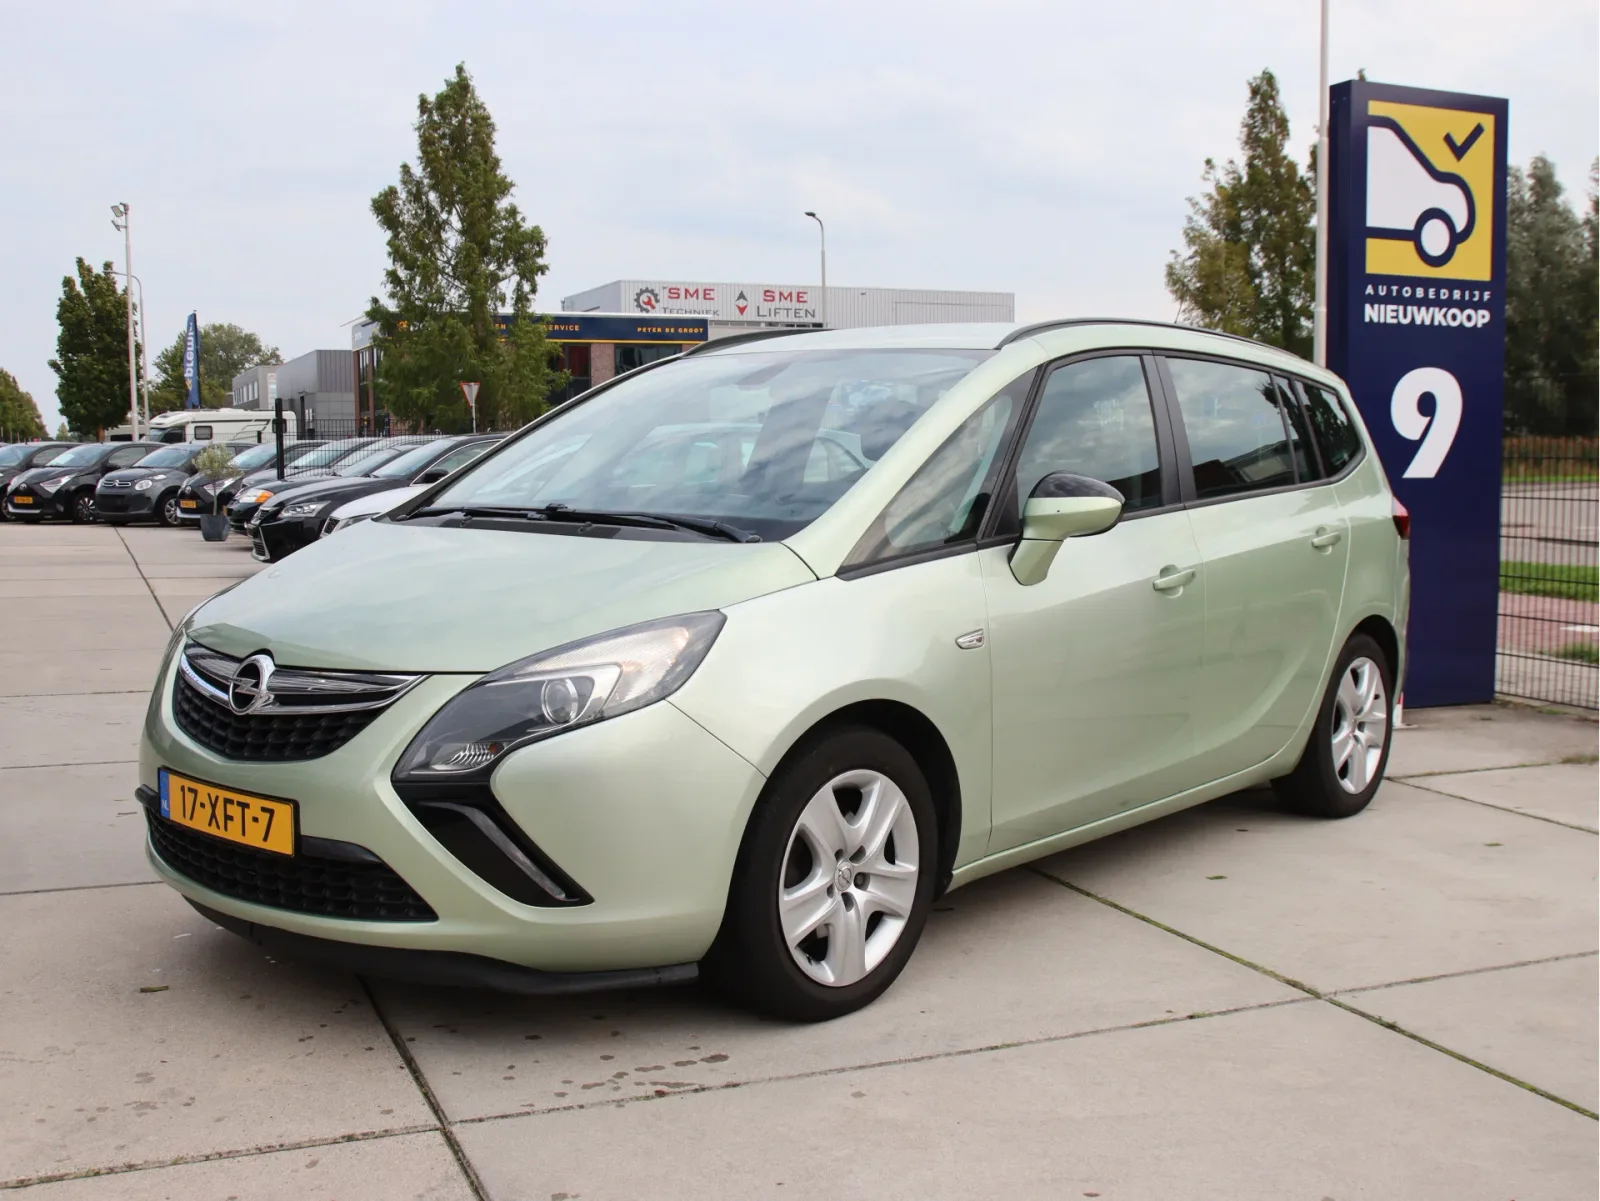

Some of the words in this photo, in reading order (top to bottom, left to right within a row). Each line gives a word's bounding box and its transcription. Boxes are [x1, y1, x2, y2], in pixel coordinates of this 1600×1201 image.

[668, 287, 715, 300] SME
[763, 289, 808, 303] SME
[1365, 284, 1491, 302] AUTOBEDRIJF
[1364, 303, 1491, 328] NIEUWKOOP
[1391, 366, 1463, 479] 9
[180, 784, 275, 842] 17-XFT-7
